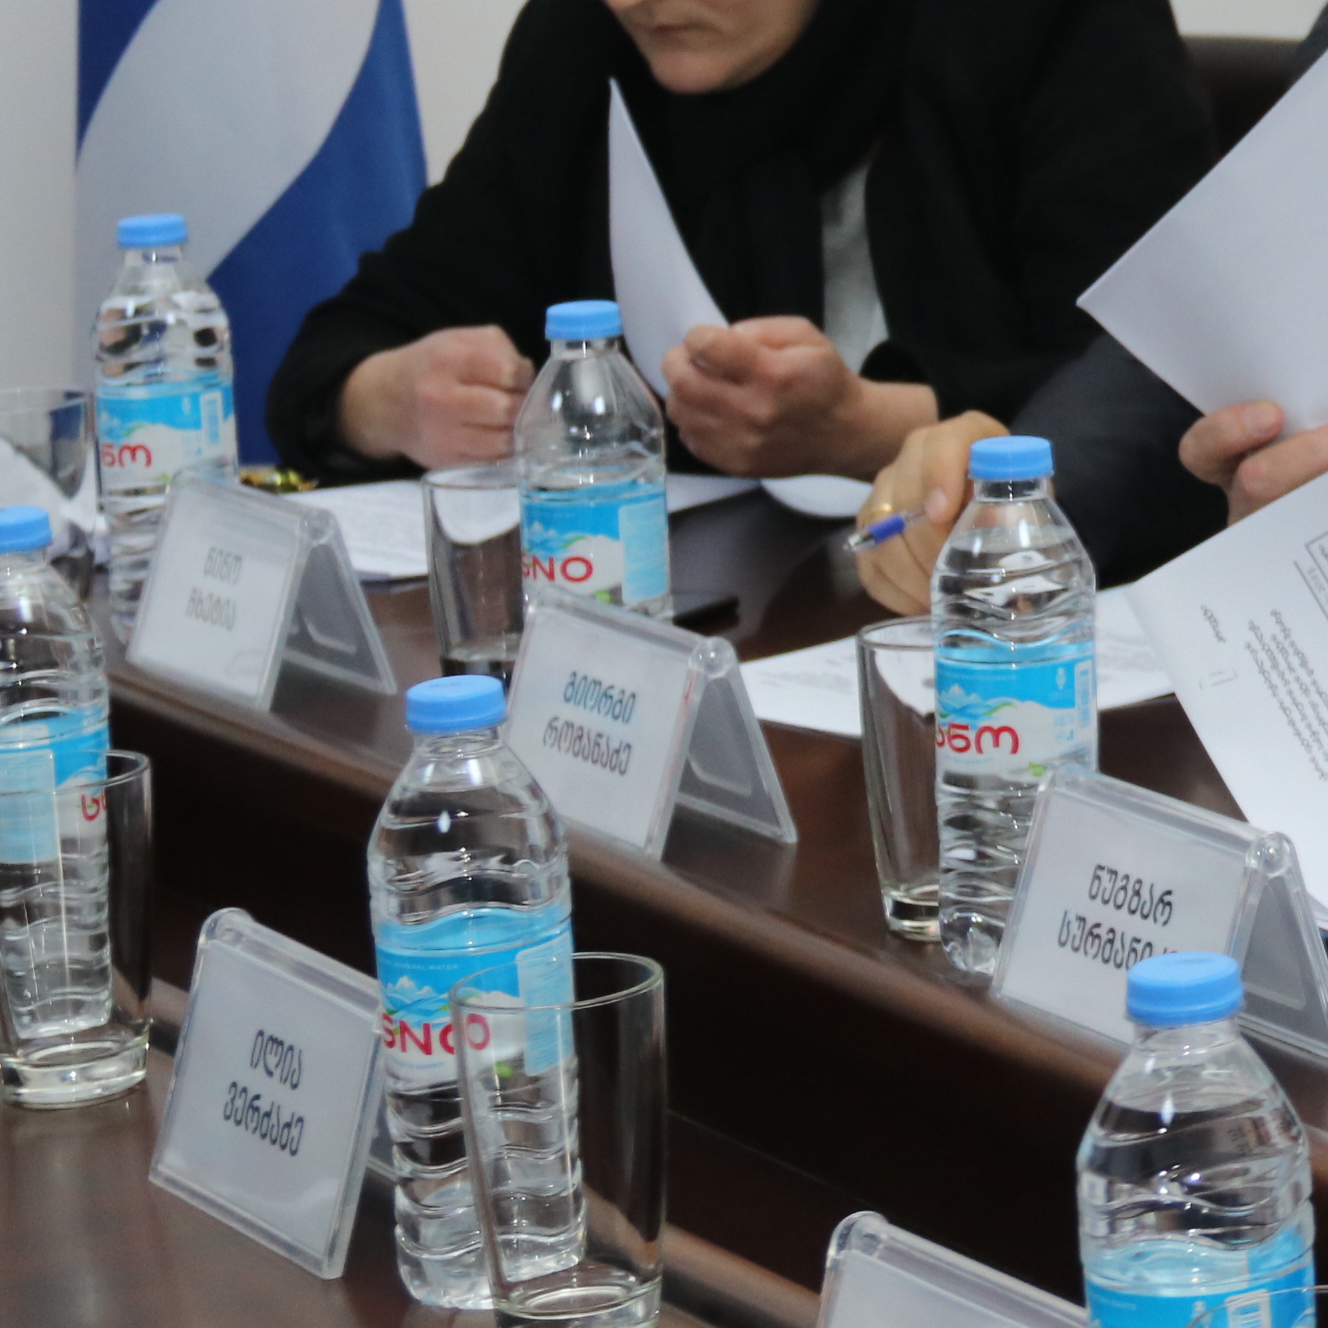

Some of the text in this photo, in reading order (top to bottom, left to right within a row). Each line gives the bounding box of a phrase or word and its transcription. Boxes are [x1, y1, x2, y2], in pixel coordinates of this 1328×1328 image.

[563, 670, 636, 725] გიორგი
[542, 716, 632, 776] რომანაძე
[1088, 864, 1173, 927] ნუგზარ
[1058, 909, 1179, 971] სურმანი
[250, 1029, 303, 1090] ილია
[223, 1081, 304, 1157] ვერძაძე
